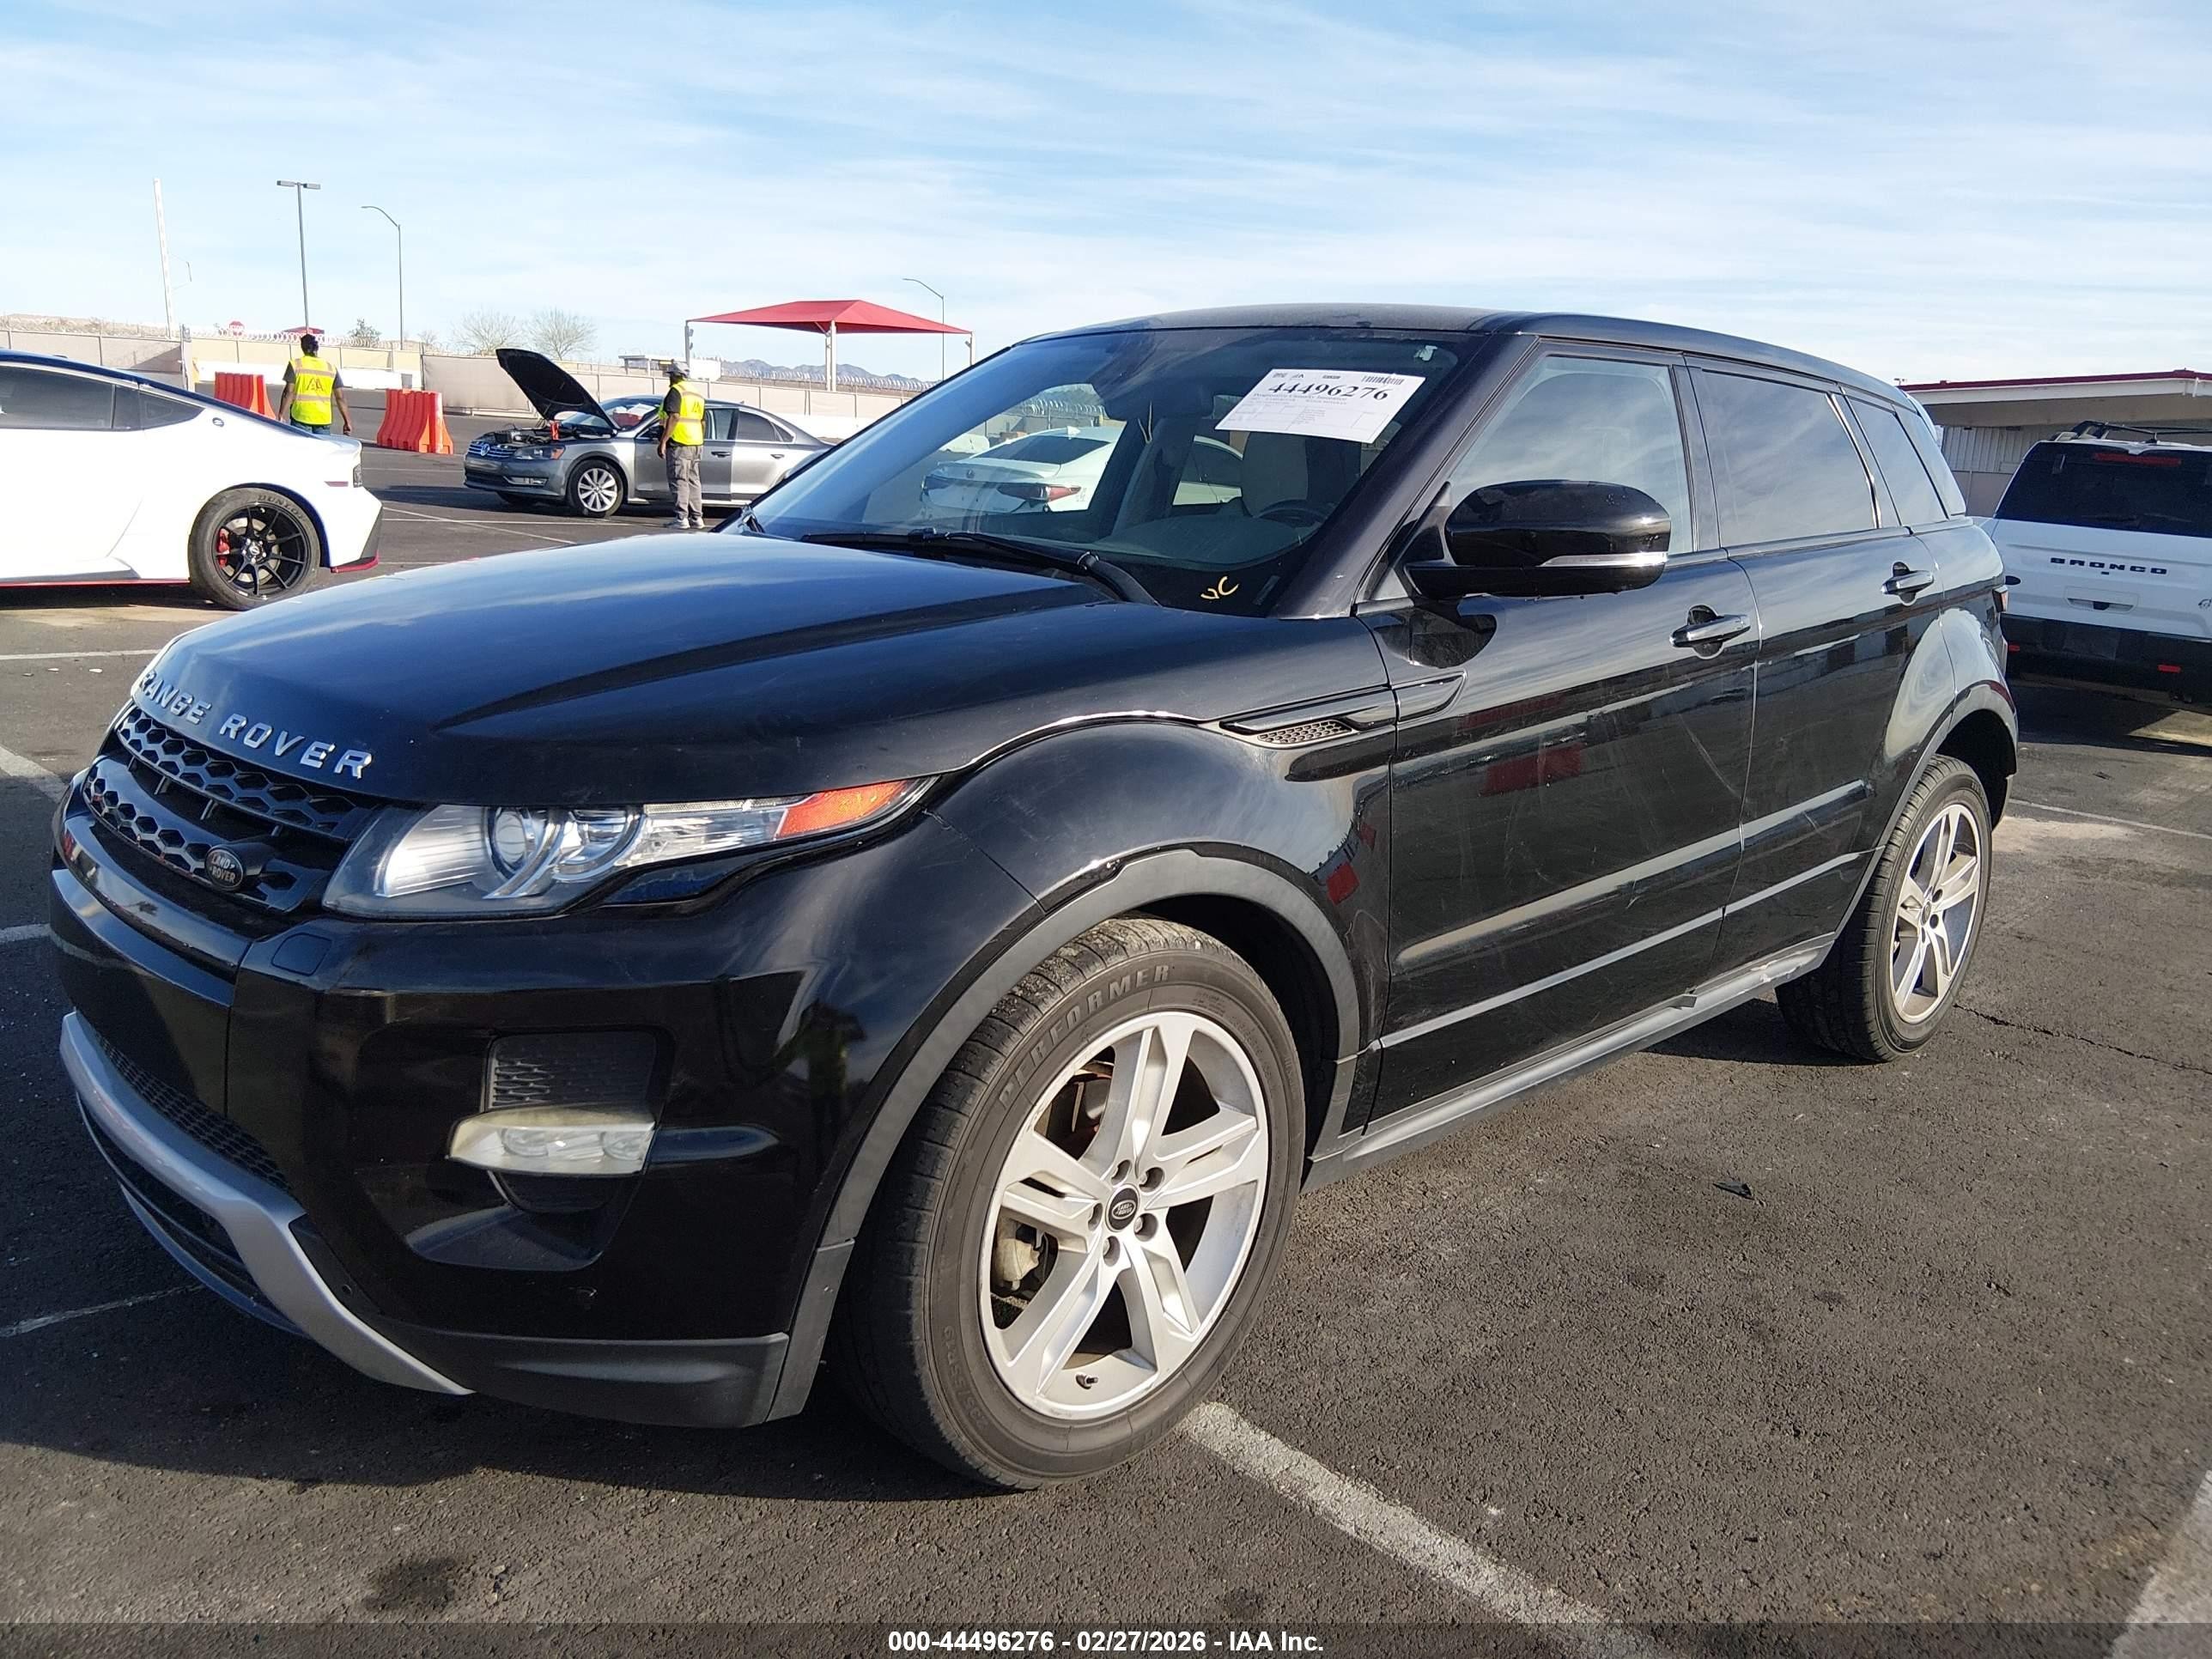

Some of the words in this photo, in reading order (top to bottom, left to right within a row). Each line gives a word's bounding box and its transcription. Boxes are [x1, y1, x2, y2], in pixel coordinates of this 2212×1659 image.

[1268, 382, 1394, 401] 44496276
[2050, 557, 2167, 574] BRONCO
[140, 670, 213, 726] RANGE
[219, 713, 373, 780] ROVER
[211, 854, 231, 869] LAND
[211, 866, 236, 884] ROVER
[998, 963, 1171, 1110] PERFORMER
